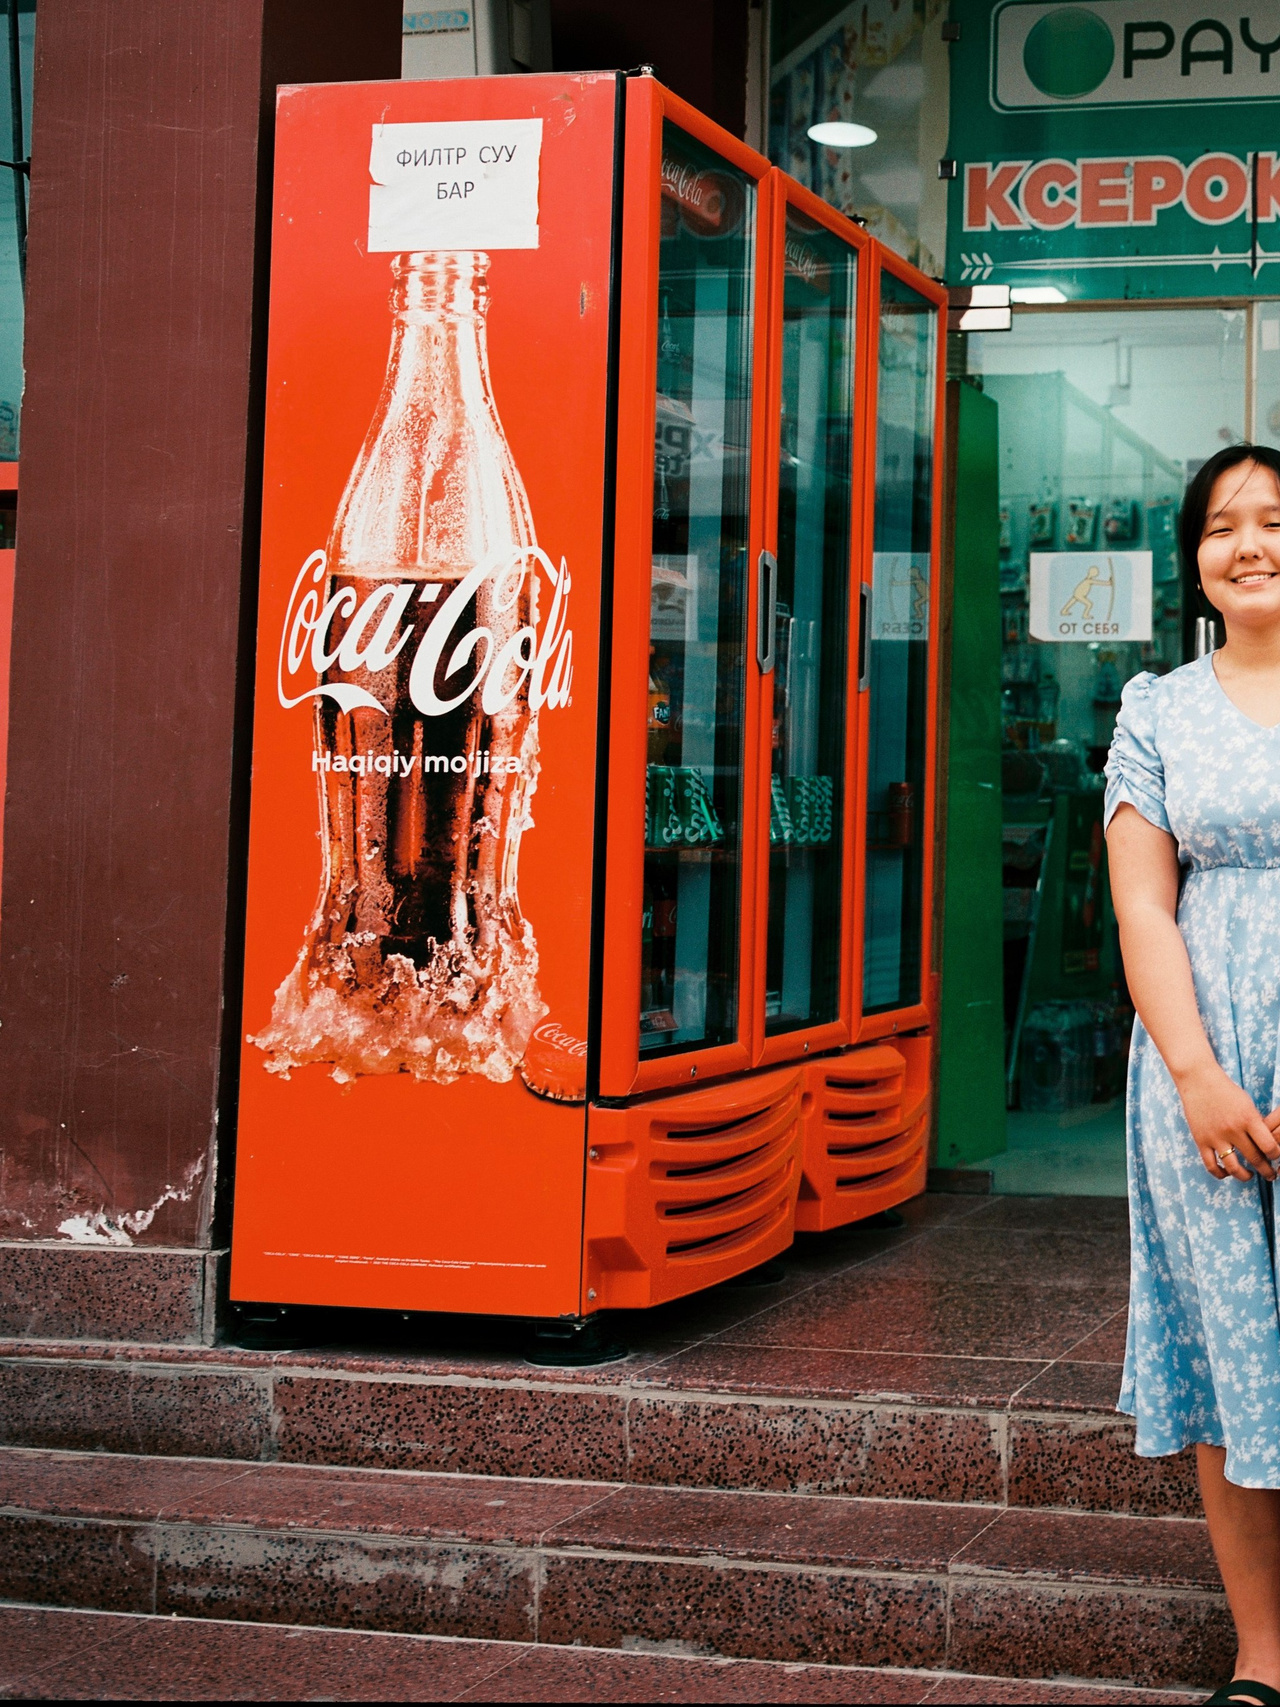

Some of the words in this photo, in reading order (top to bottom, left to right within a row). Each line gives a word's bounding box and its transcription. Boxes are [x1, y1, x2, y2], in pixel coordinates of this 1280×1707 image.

[396, 146, 467, 167] ФИЛТР
[478, 144, 517, 164] СУУ
[436, 180, 475, 200] БАР
[661, 158, 704, 206] oca-Cola
[278, 543, 574, 716] Coca-Cola
[1059, 622, 1077, 635] ОТ
[1083, 622, 1120, 635] СЕБЯ
[653, 706, 671, 720] FAN
[311, 749, 417, 777] Haqiqiy
